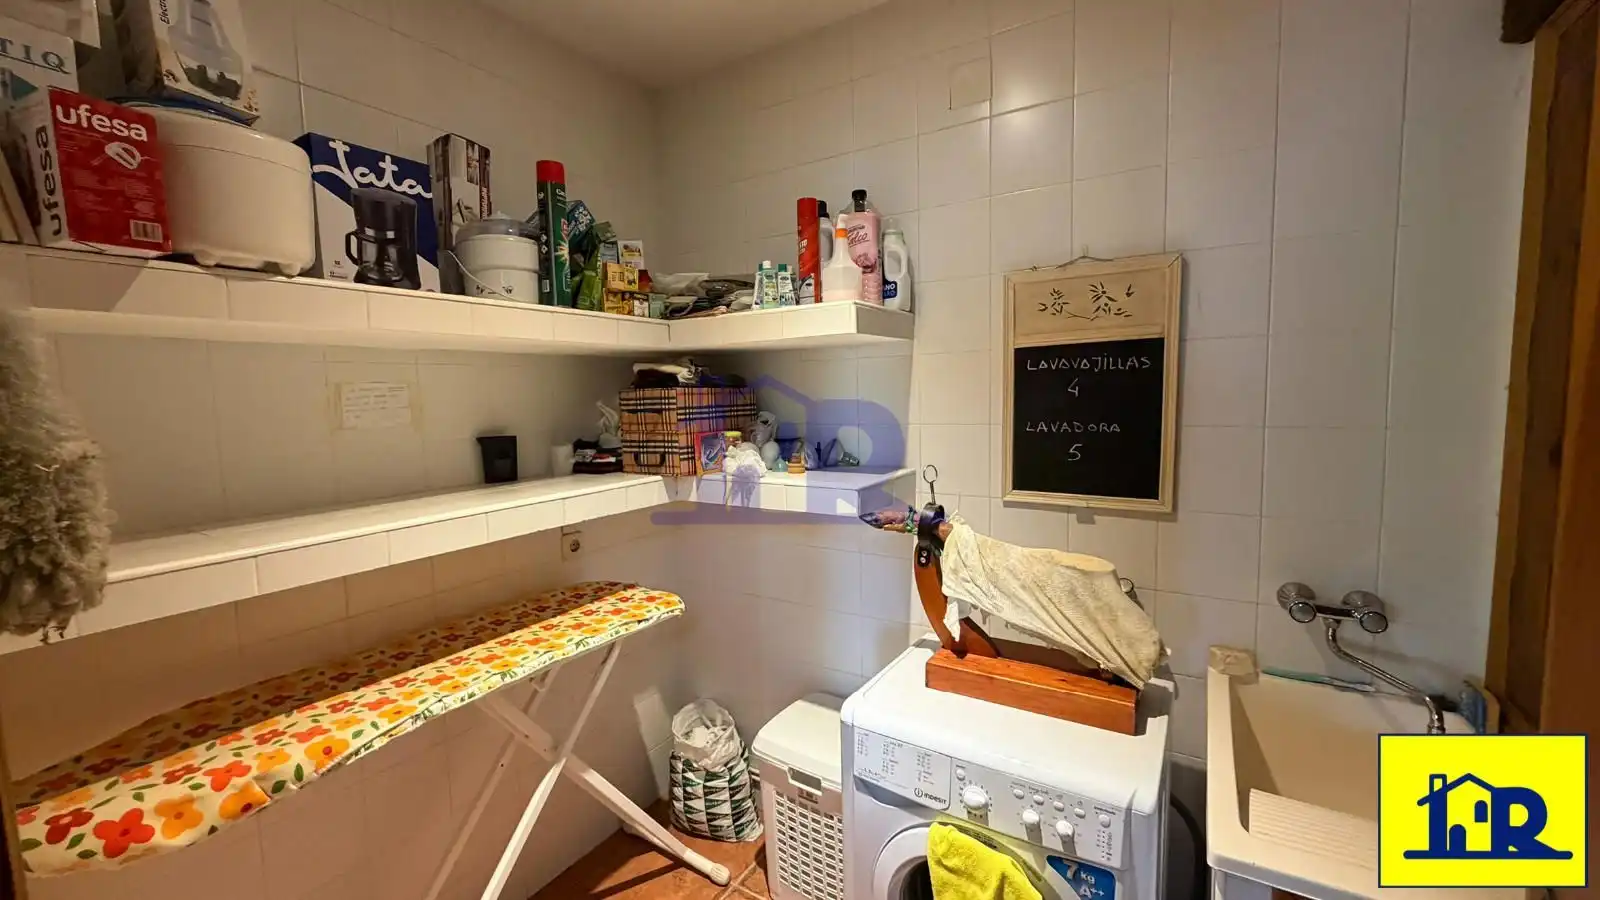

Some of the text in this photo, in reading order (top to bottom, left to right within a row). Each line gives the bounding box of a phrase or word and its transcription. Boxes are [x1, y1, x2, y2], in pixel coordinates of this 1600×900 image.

[55, 103, 148, 142] ufesa
[312, 139, 433, 199] Jata
[35, 126, 62, 237] ufesa
[1026, 352, 1152, 373] LAVAVAJILLAS
[1067, 377, 1079, 398] 4
[1025, 420, 1121, 434] LAVADORA
[1067, 443, 1083, 461] 5
[1063, 859, 1096, 885] 7 kg
